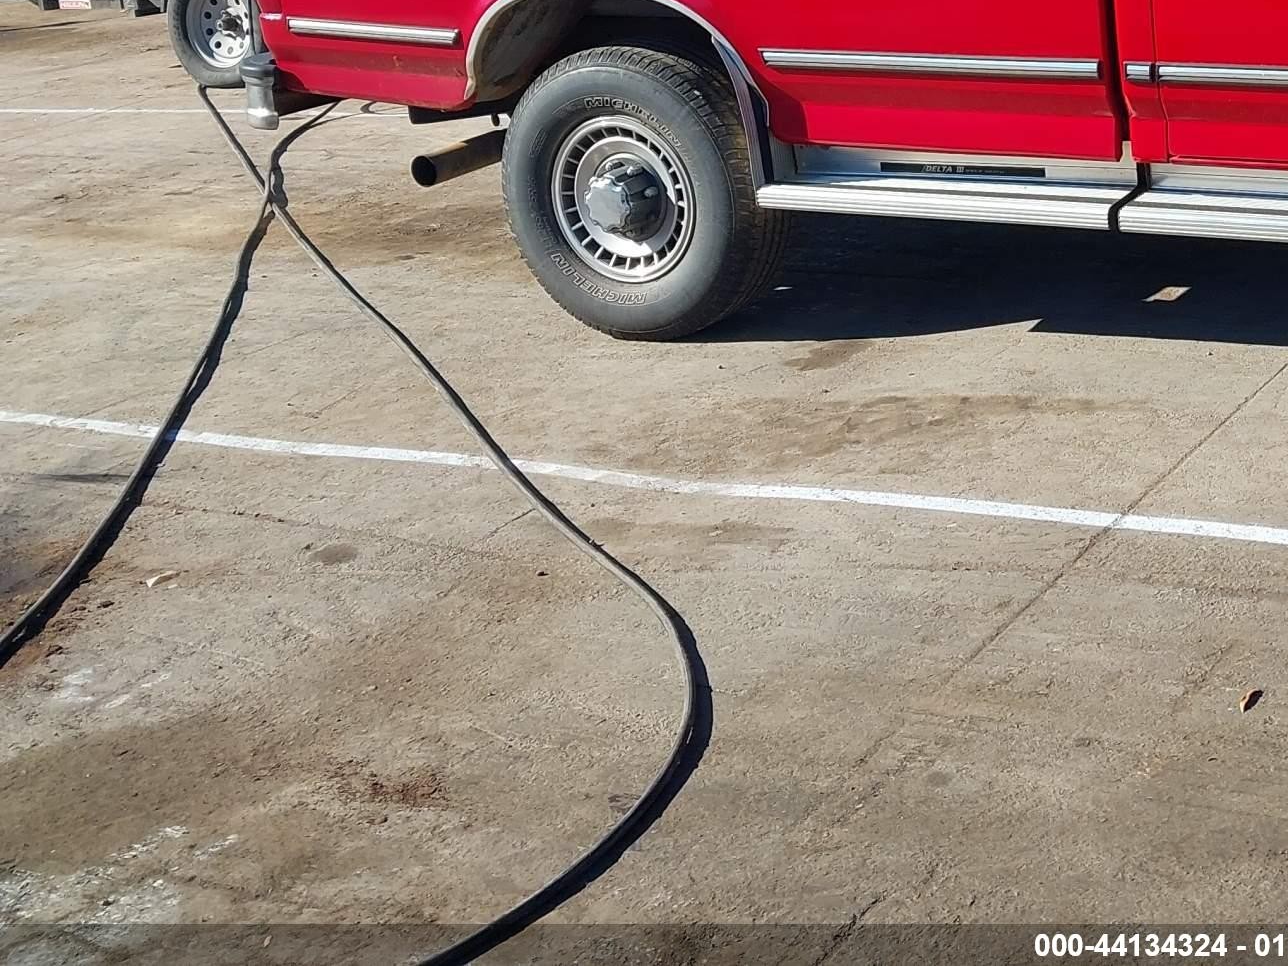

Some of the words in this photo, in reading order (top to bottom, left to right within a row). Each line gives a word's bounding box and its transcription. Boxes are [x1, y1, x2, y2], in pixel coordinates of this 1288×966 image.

[584, 96, 682, 150] MICHELIN
[925, 165, 953, 173] DELTA
[551, 252, 648, 305] MICHELIN
